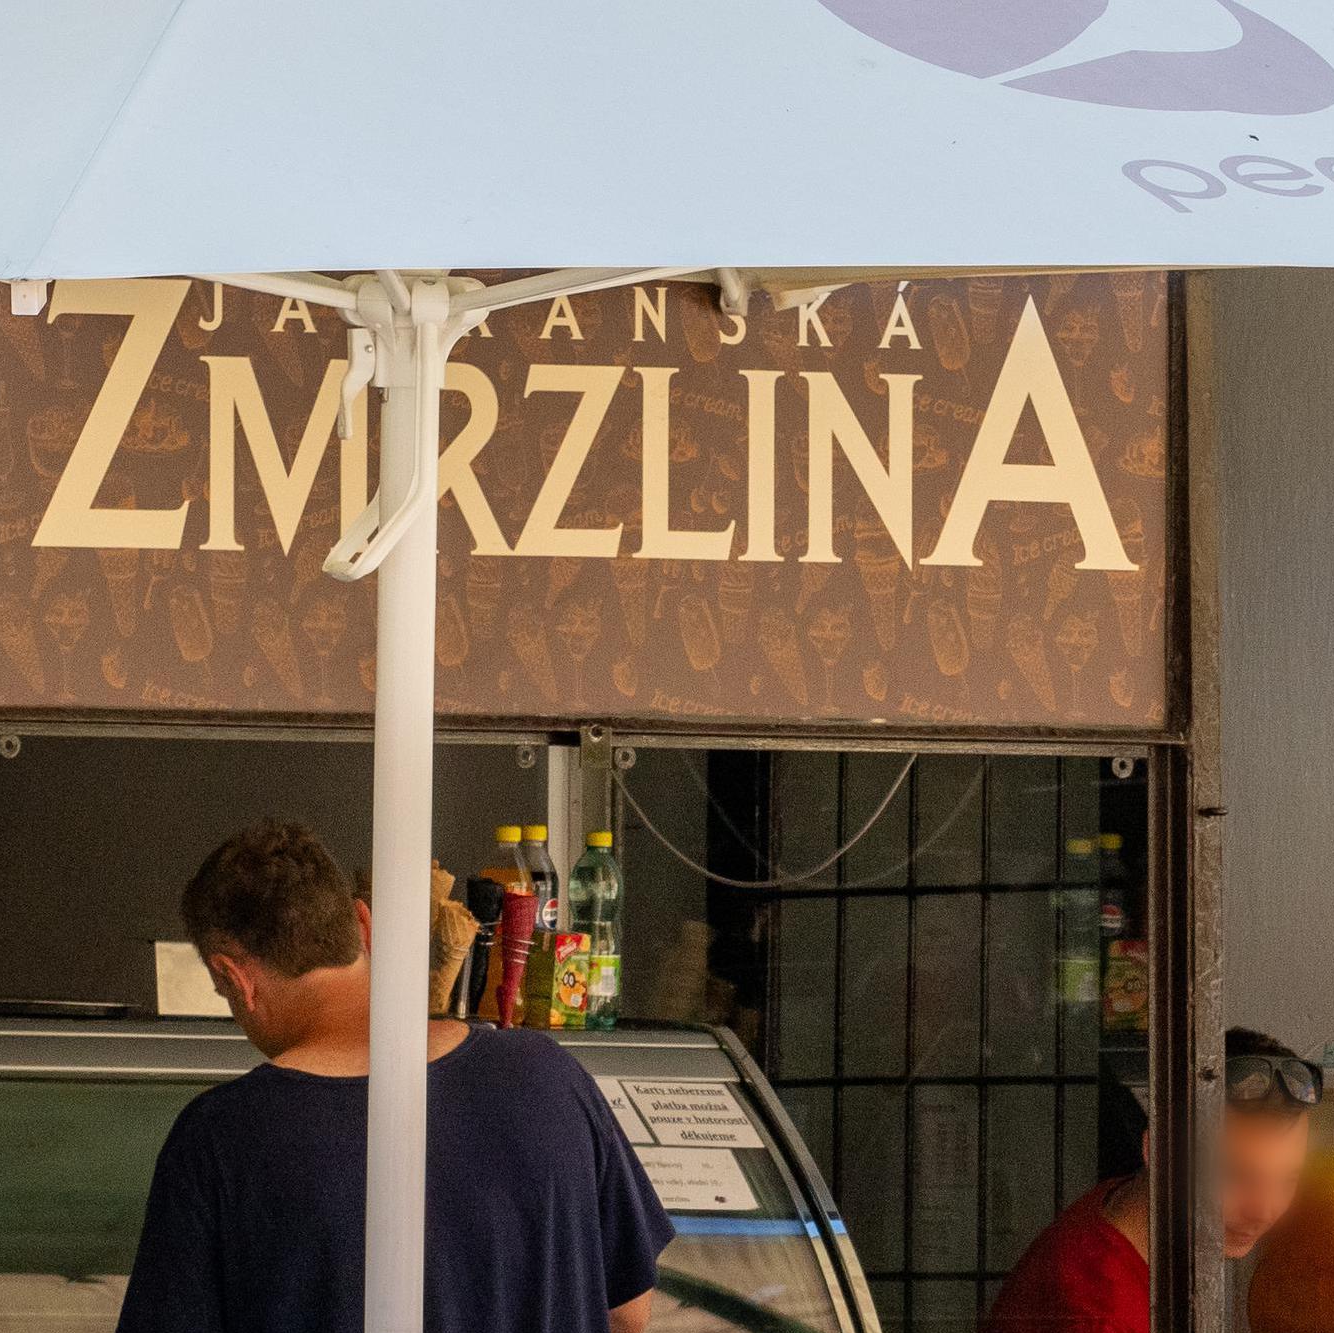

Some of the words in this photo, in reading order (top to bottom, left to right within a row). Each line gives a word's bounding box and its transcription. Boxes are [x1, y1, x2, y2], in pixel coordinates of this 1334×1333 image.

[31, 279, 1139, 572] ZMRZLINA
[633, 1085, 666, 1096] Karty
[668, 1086, 725, 1096] nebereme
[651, 1101, 689, 1112] platba
[648, 1116, 683, 1125] pouze
[693, 1115, 748, 1126] hotovosti
[680, 1130, 737, 1141] děkujeme
